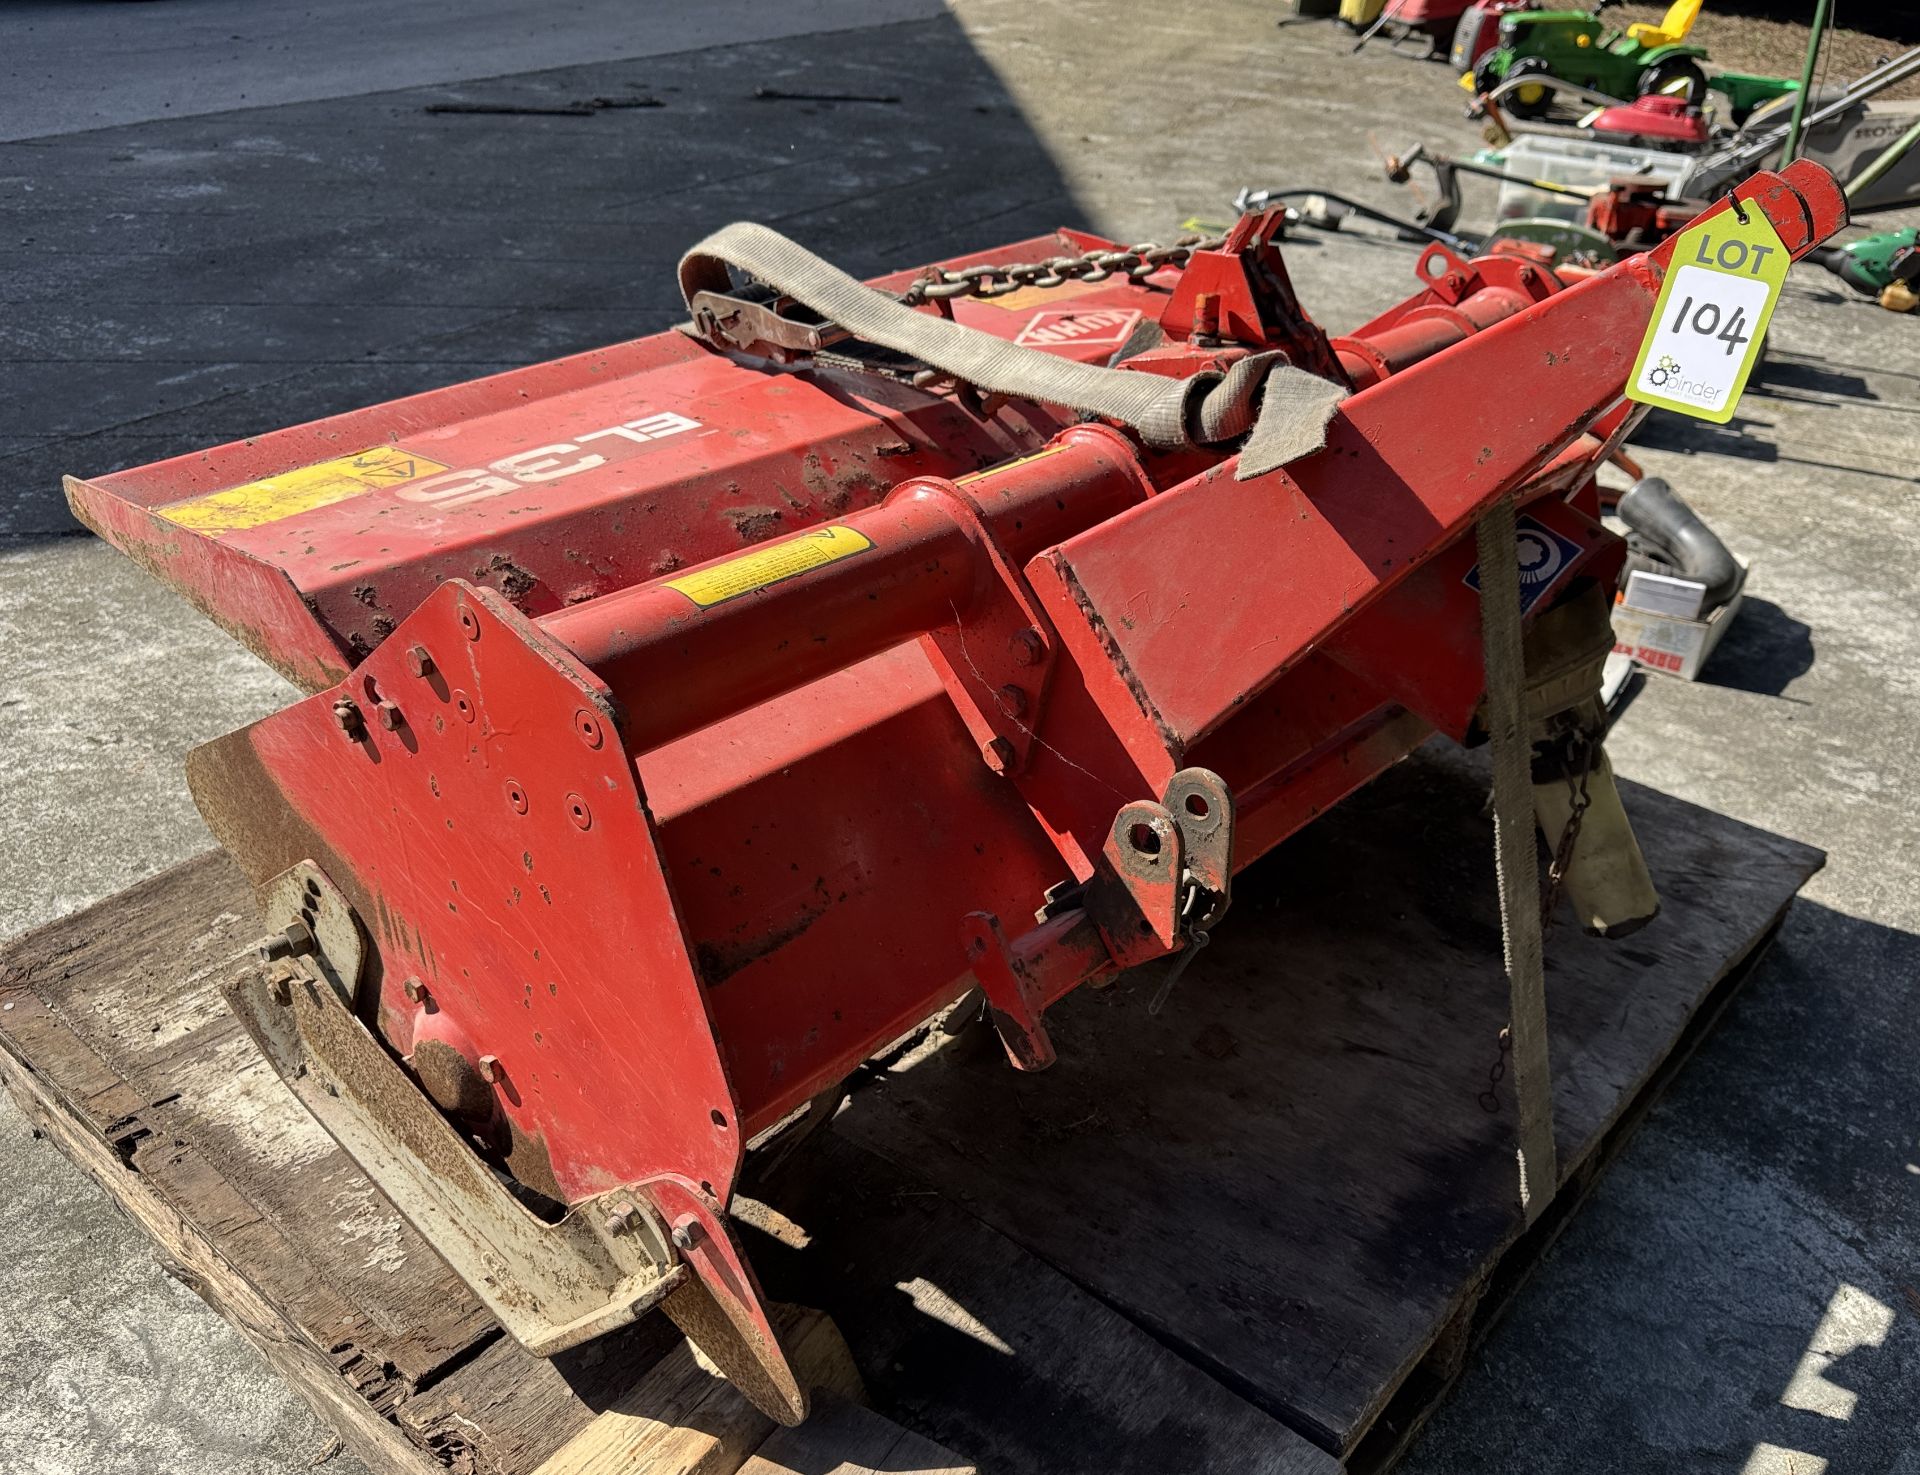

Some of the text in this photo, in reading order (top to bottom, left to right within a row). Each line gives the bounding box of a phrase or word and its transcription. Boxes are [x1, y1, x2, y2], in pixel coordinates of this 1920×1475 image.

[1695, 234, 1774, 275] LOT
[1028, 311, 1131, 343] KUHN
[1671, 296, 1748, 356] 104
